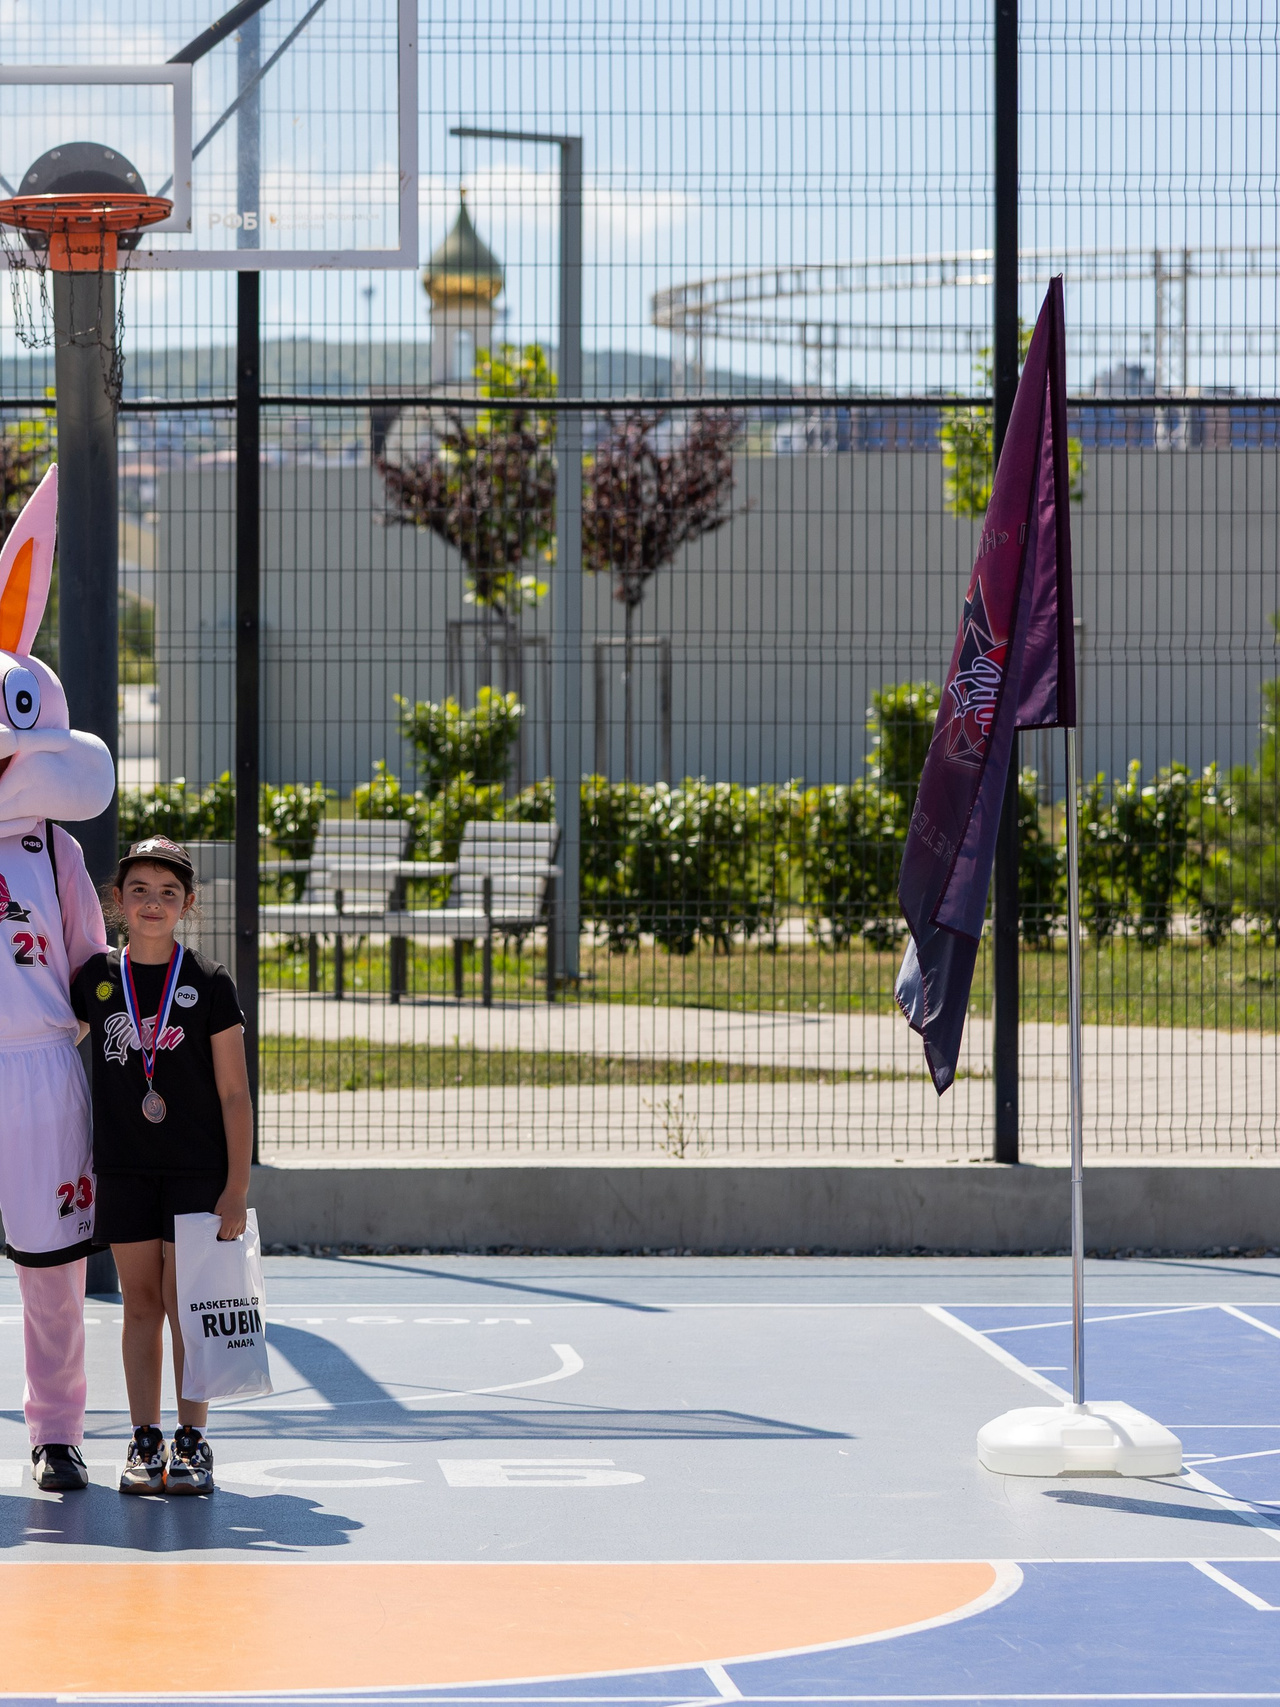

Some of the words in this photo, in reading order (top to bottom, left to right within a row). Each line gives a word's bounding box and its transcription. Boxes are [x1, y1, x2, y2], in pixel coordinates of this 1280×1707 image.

[208, 212, 257, 230] РФБ
[23, 840, 42, 849] РФБ
[177, 991, 197, 1001] РФБ
[55, 1174, 95, 1220] 23
[190, 1298, 250, 1312] BASKETBALL
[201, 1309, 263, 1338] RUBIN
[227, 1338, 255, 1349] ANAPA
